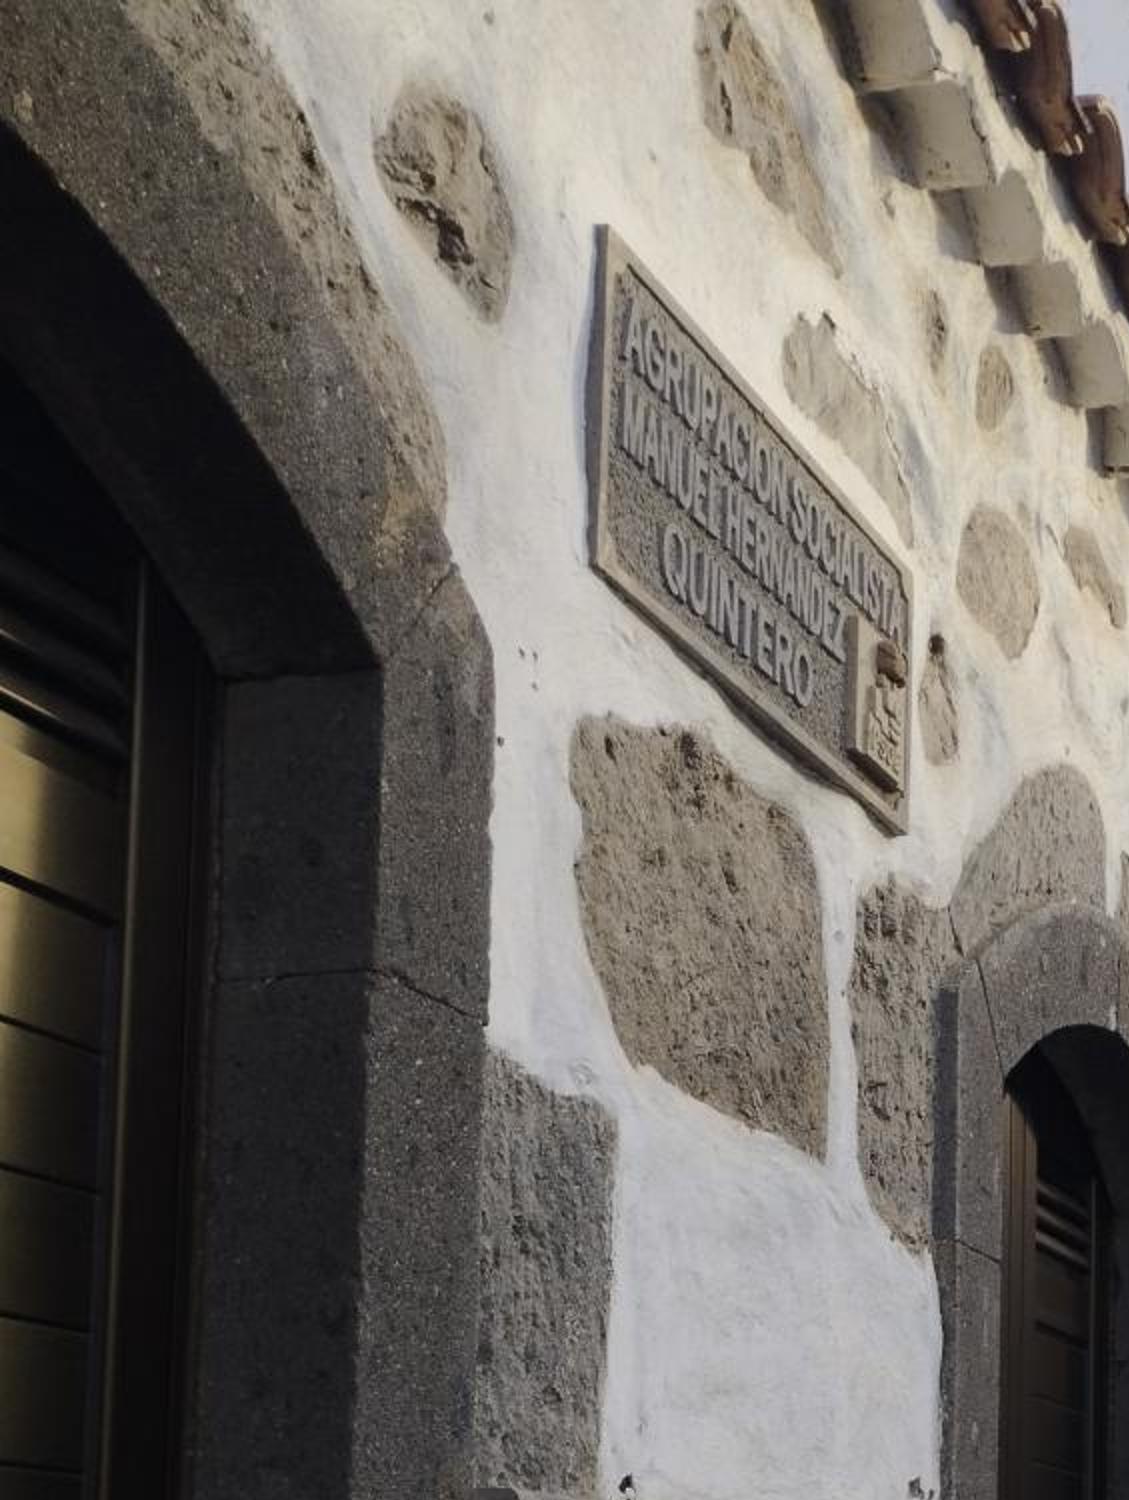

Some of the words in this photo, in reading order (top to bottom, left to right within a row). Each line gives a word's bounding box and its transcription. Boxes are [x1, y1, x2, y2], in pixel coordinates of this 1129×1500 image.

[620, 385, 720, 540] MANUEL
[722, 484, 847, 665] HERNANDEZ
[622, 298, 789, 526] AGRUPACION
[789, 480, 901, 642] SOCIALISTA
[662, 523, 813, 708] QUINTERO
